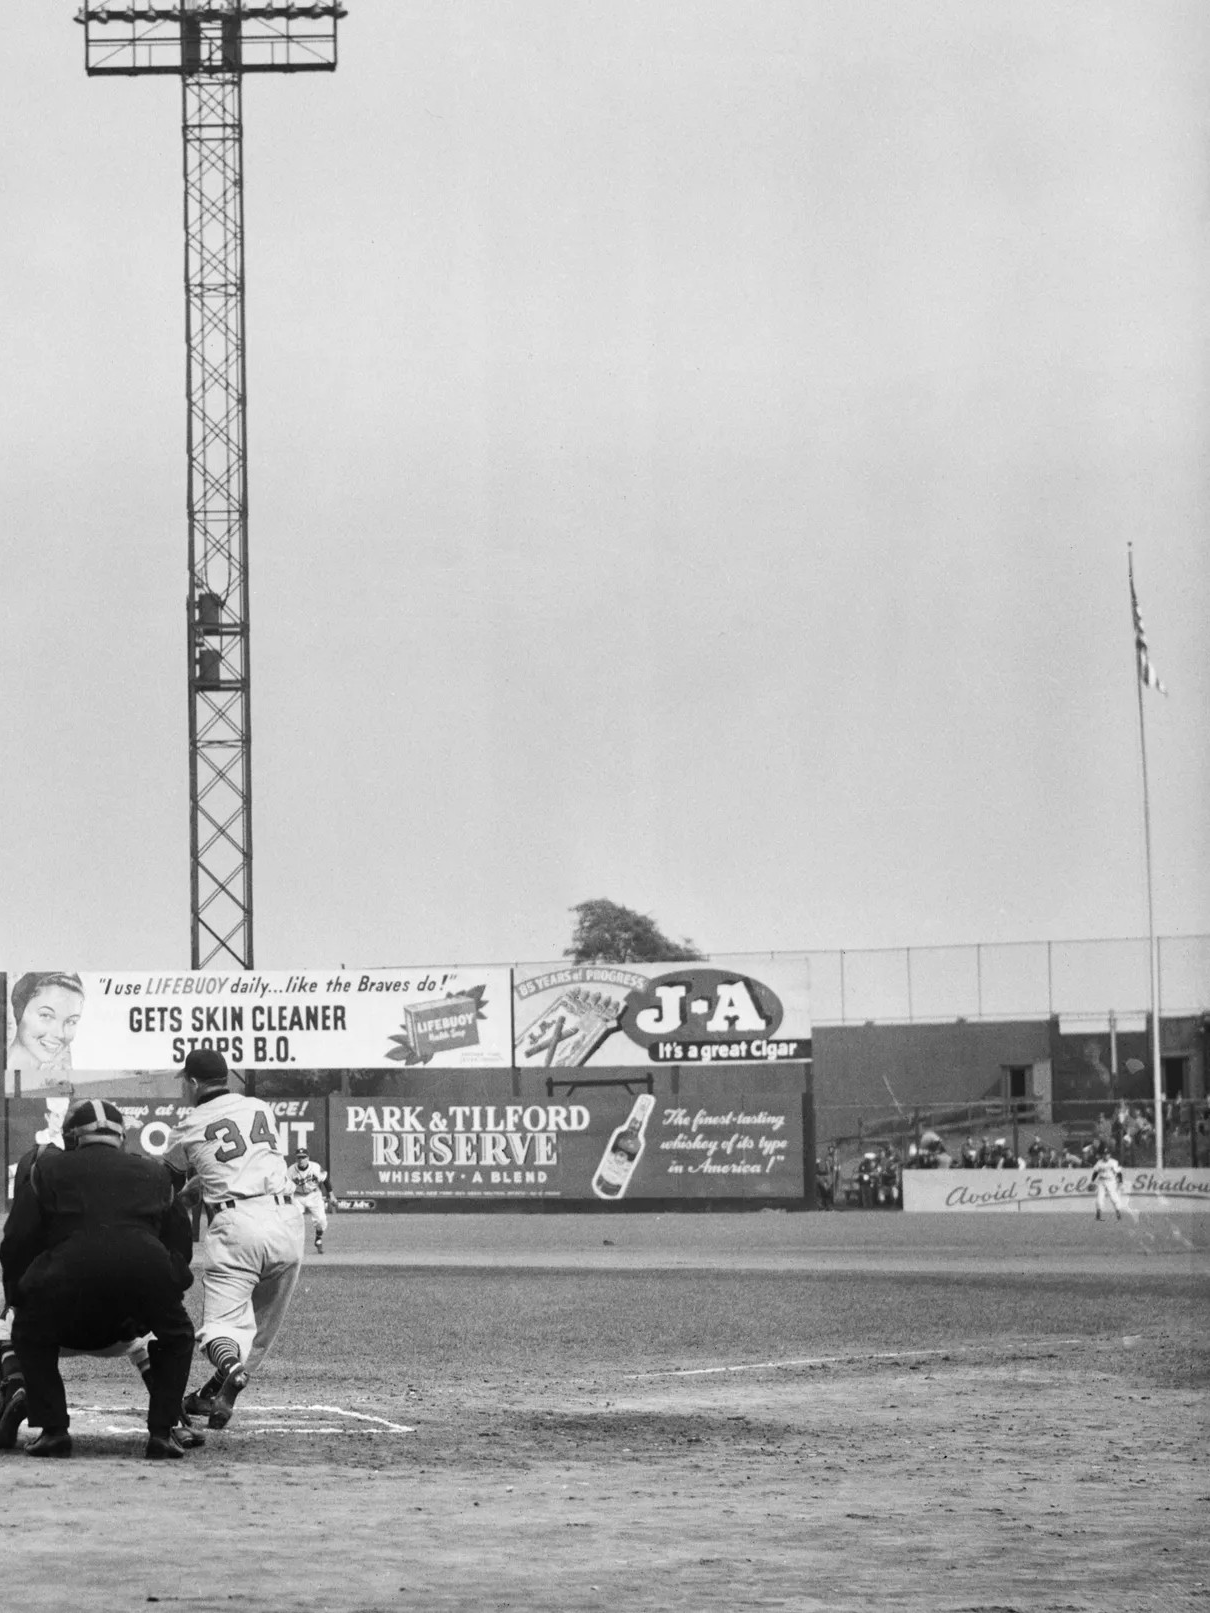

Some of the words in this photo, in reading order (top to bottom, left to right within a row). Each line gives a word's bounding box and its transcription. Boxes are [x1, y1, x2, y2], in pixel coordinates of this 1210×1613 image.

[114, 982, 142, 995] use
[145, 977, 229, 995] LIFEBUOY
[326, 976, 351, 993] the
[357, 975, 410, 993] Braves
[535, 971, 572, 989] YEARS
[586, 969, 645, 989] PROGRESS
[129, 1006, 183, 1033] GETS
[191, 1006, 243, 1032] SKIN
[252, 1005, 346, 1032] CLEANER
[417, 1013, 474, 1033] LIFEBUOY
[254, 1036, 296, 1063] B.O.
[658, 1041, 684, 1059] It's
[688, 1046, 699, 1058] a
[701, 1040, 748, 1062] great
[750, 1039, 798, 1061] Cigar
[155, 1104, 175, 1116] at
[346, 1106, 426, 1132] PARK
[429, 1111, 448, 1132] &
[448, 1105, 590, 1132] TILFORD
[662, 1108, 690, 1126] The
[204, 1110, 278, 1163] 34
[660, 1133, 718, 1156] whiskey
[721, 1133, 739, 1155] of
[737, 1136, 754, 1149] its
[758, 1136, 788, 1156] type
[371, 1132, 558, 1166] RESERVE
[379, 1171, 456, 1183] WHISKEY
[472, 1171, 483, 1183] A
[491, 1171, 548, 1183] BLEND
[667, 1160, 684, 1173] in
[945, 1181, 1018, 1207] Avoid
